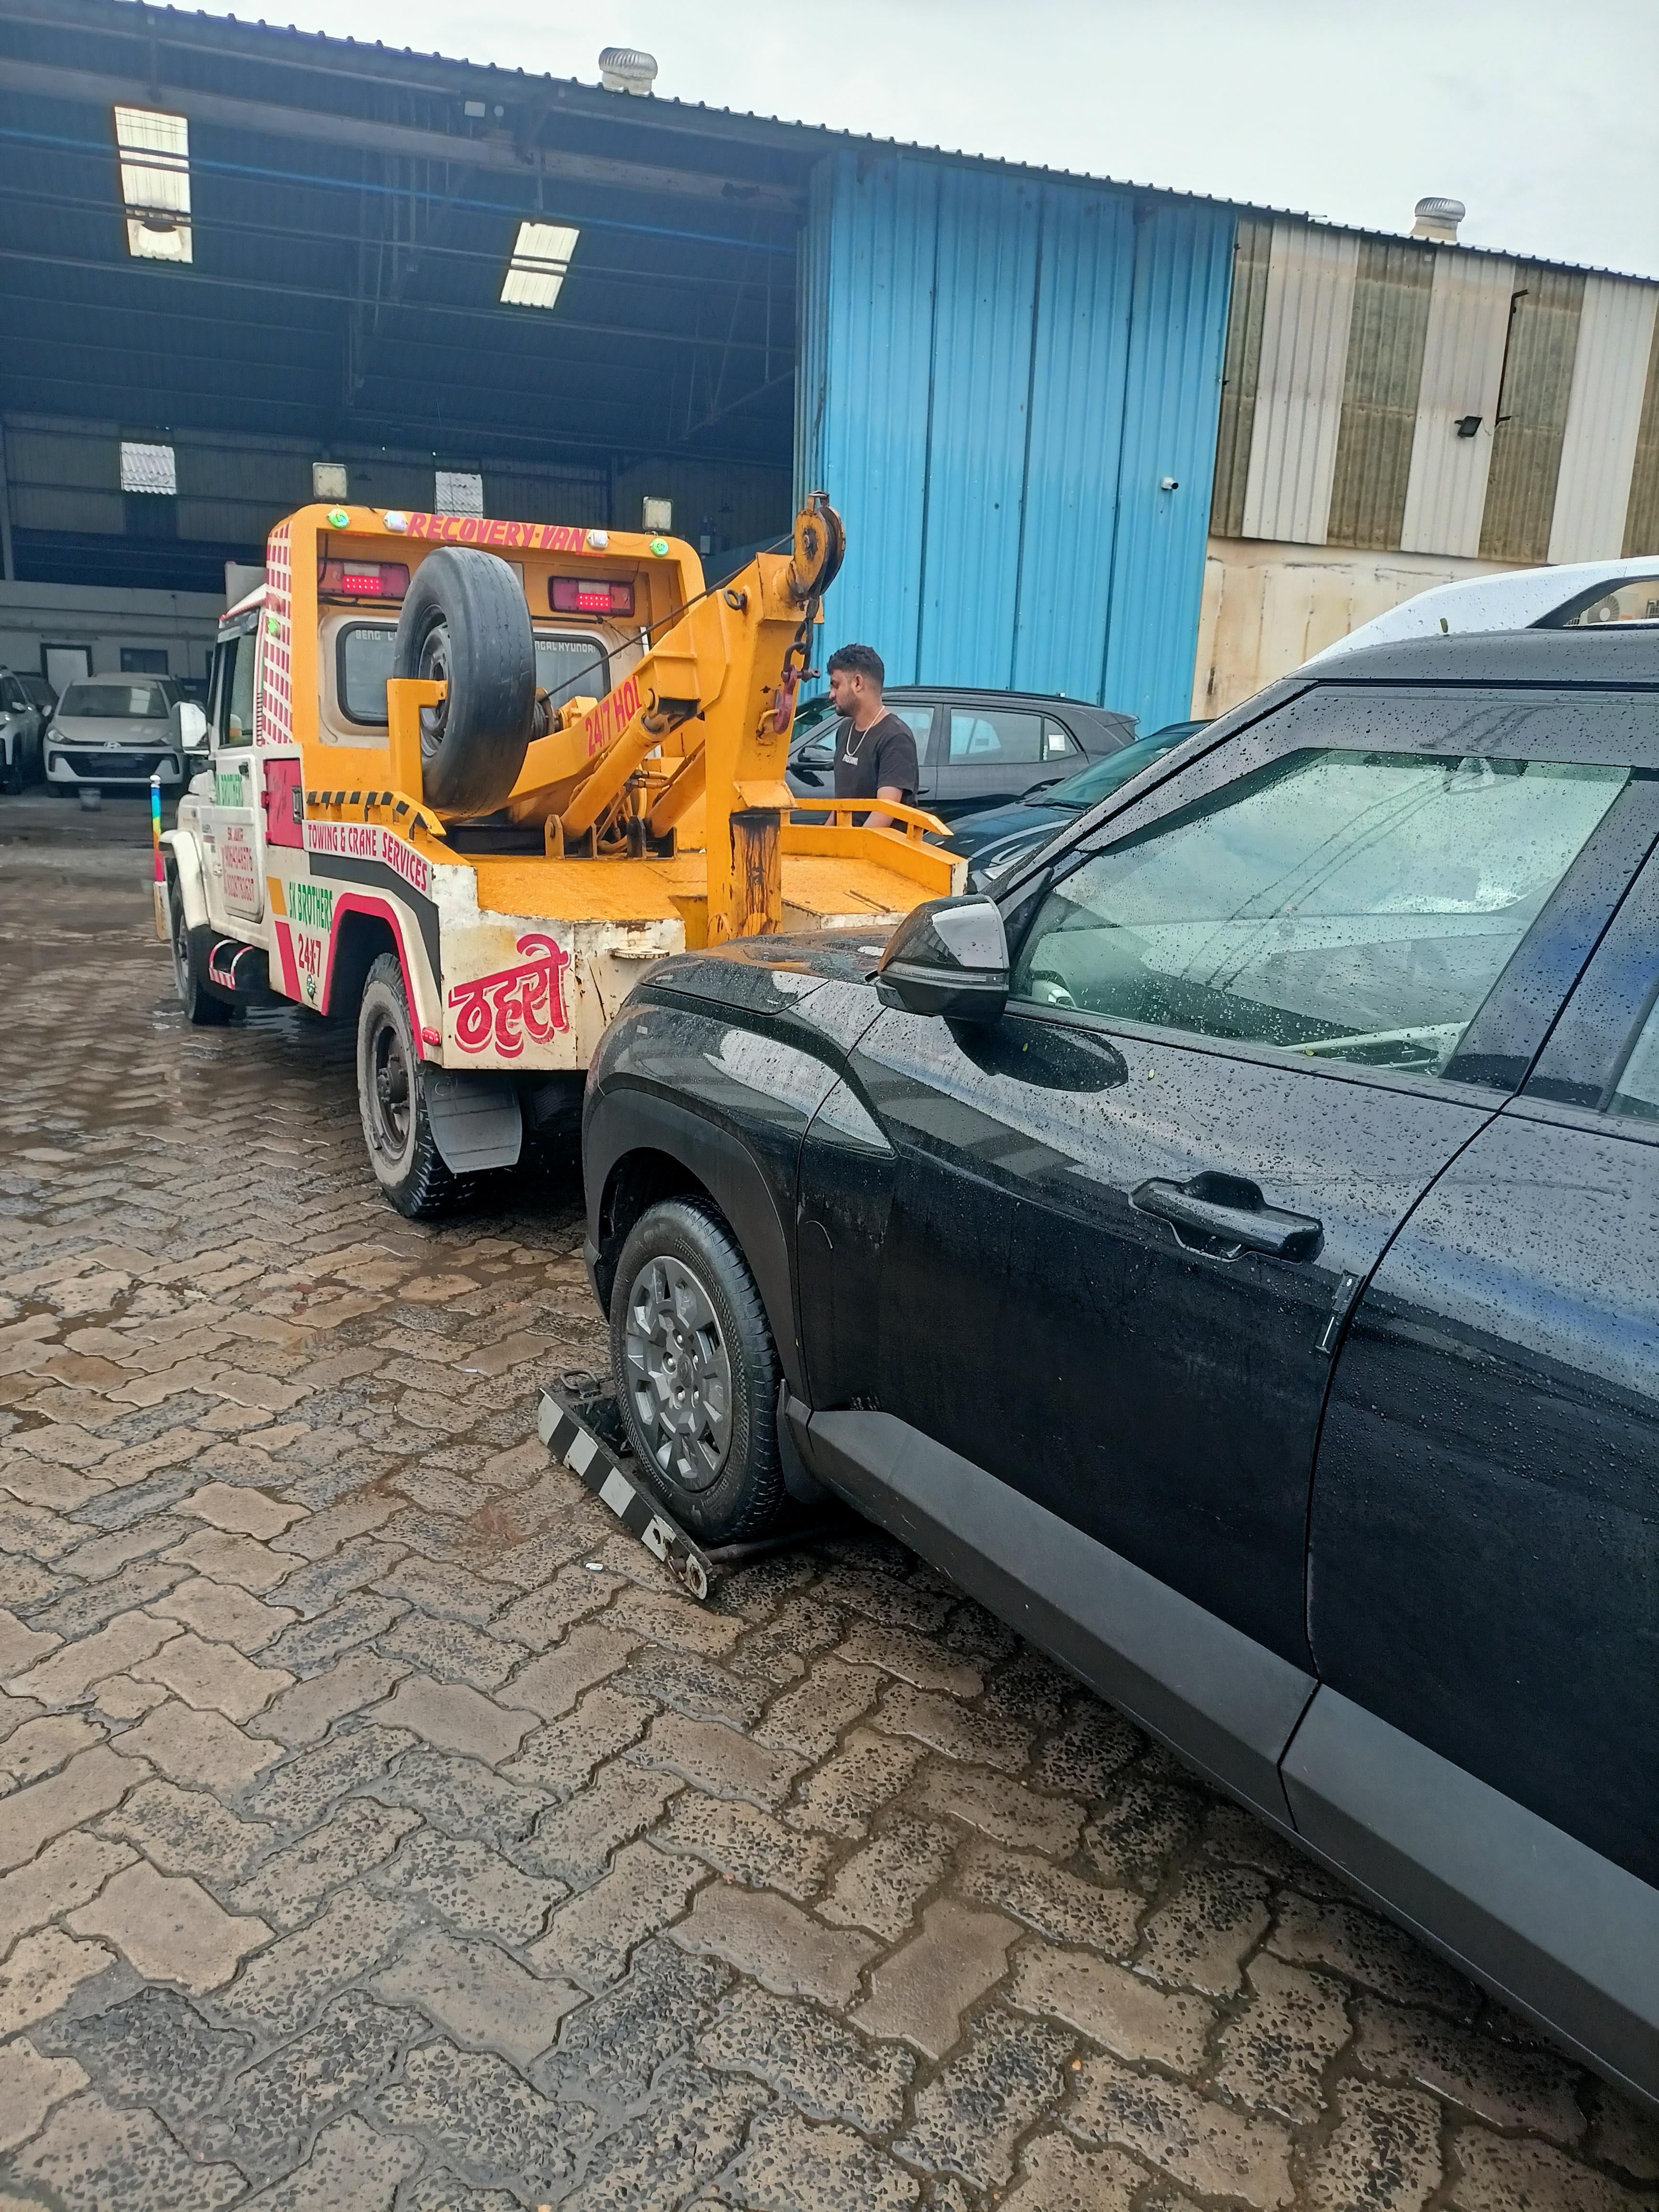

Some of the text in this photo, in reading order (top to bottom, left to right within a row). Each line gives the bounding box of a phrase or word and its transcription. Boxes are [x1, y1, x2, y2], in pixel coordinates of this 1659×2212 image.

[558, 642, 596, 653] HYUNDAI
[308, 824, 427, 891] TOWING & CRANE SERVICES
[289, 881, 332, 933] SK BROTHERS
